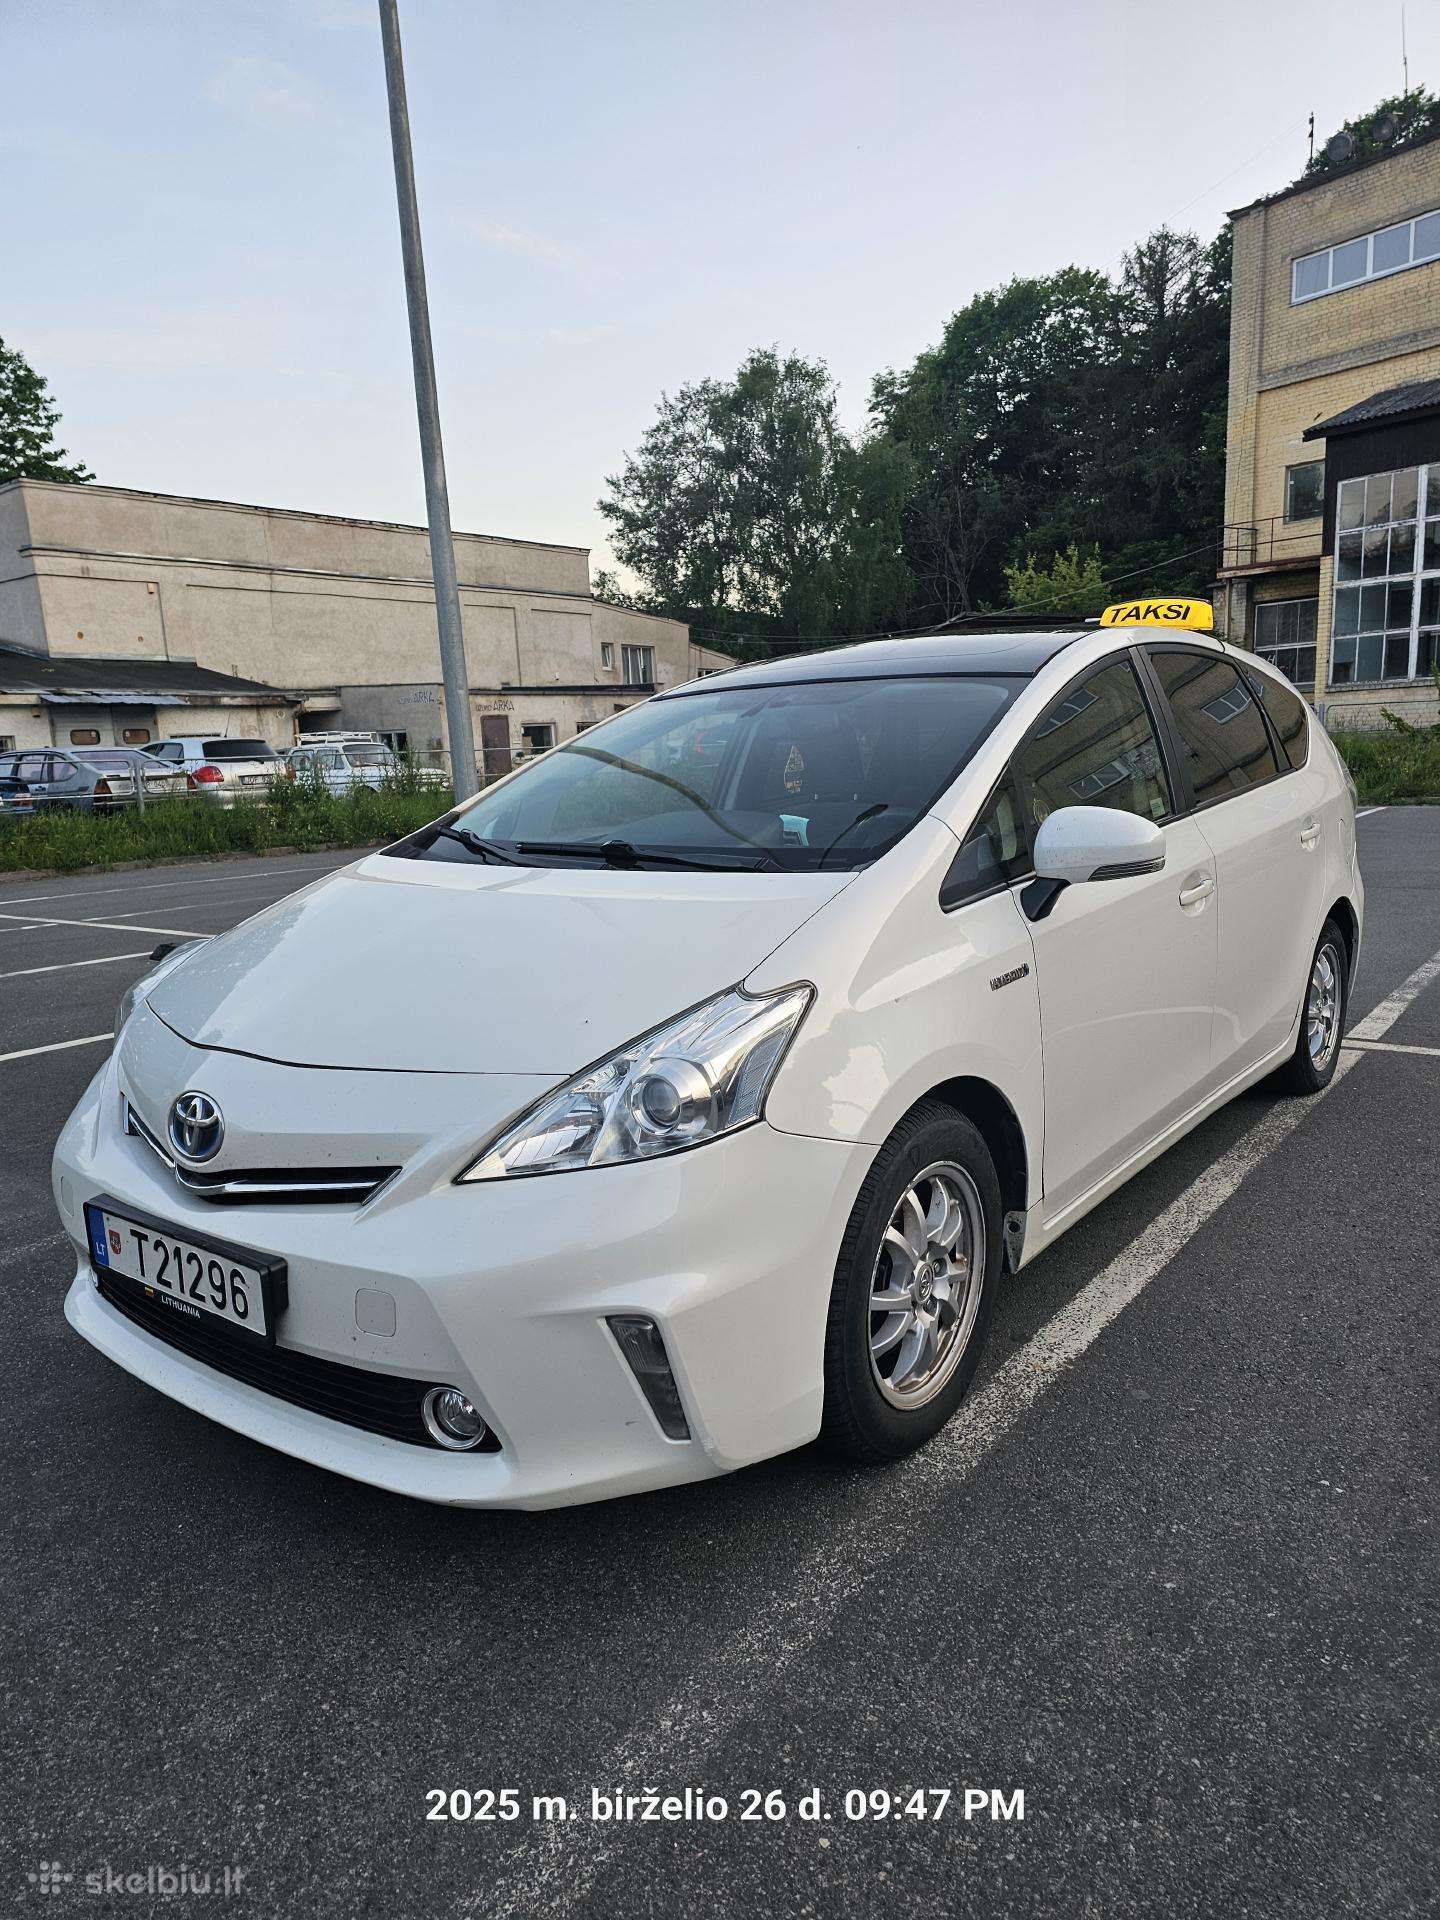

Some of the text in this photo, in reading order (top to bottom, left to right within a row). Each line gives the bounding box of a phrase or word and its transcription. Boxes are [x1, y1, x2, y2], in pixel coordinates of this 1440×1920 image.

[1111, 604, 1191, 623] TAKSI
[493, 699, 515, 711] ARKA
[95, 1242, 106, 1256] LT
[130, 1228, 249, 1320] T21296
[161, 1294, 201, 1319] LITHUANIA
